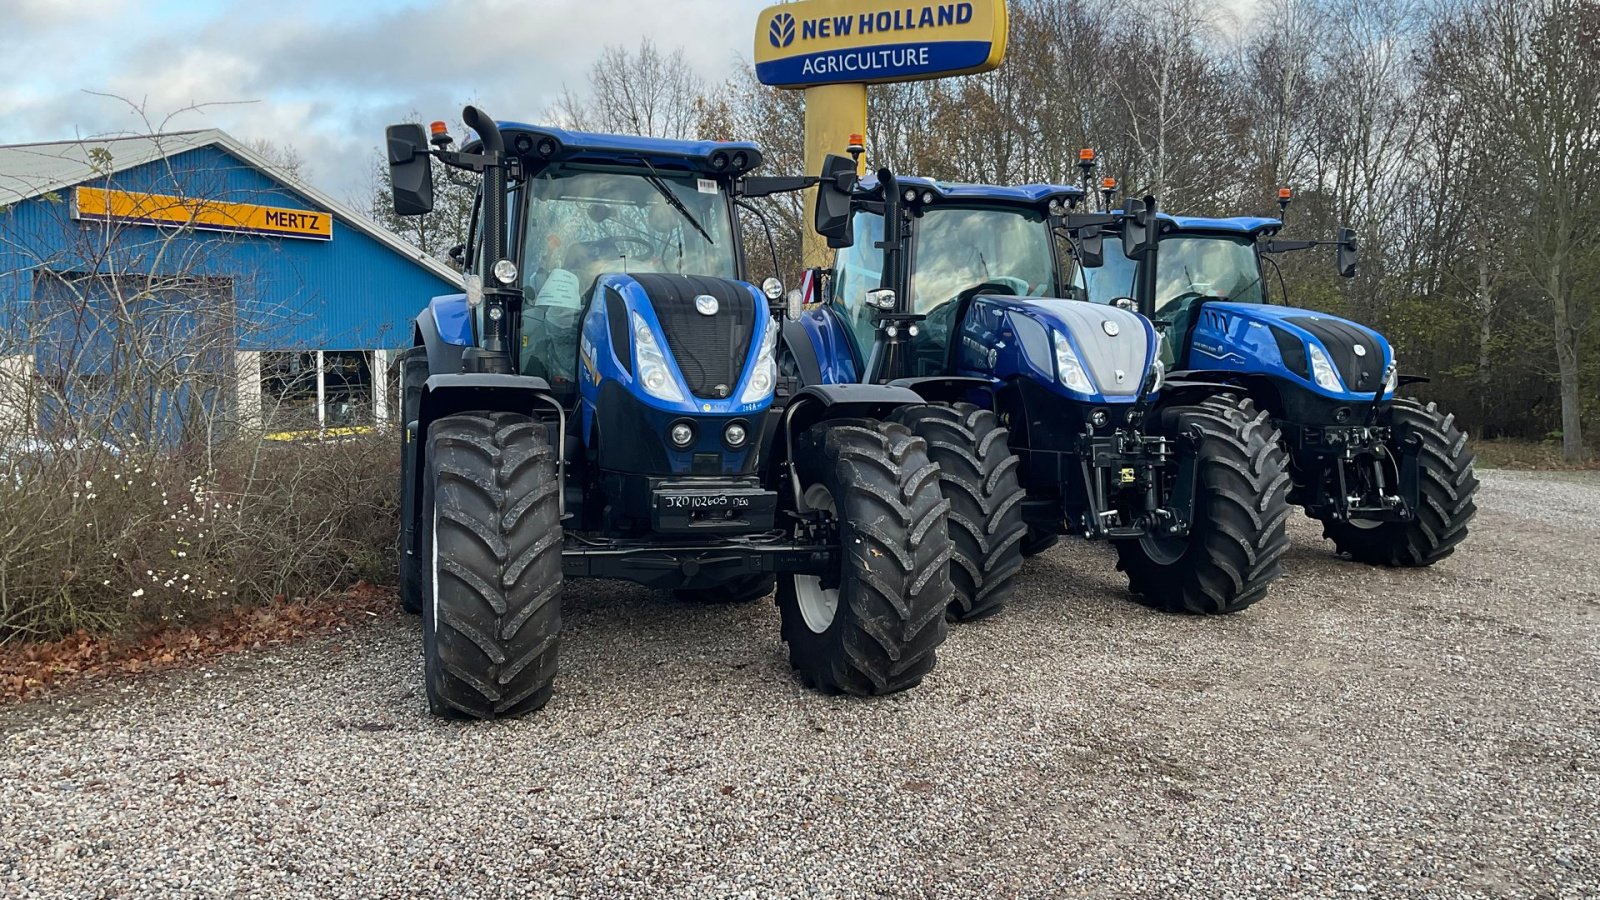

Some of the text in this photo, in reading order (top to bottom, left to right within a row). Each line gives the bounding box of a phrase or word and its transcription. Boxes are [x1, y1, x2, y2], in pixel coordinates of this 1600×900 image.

[802, 2, 973, 40] NEW HOLLAND
[802, 47, 929, 76] AGRICULTURE
[265, 210, 320, 230] MERTZ
